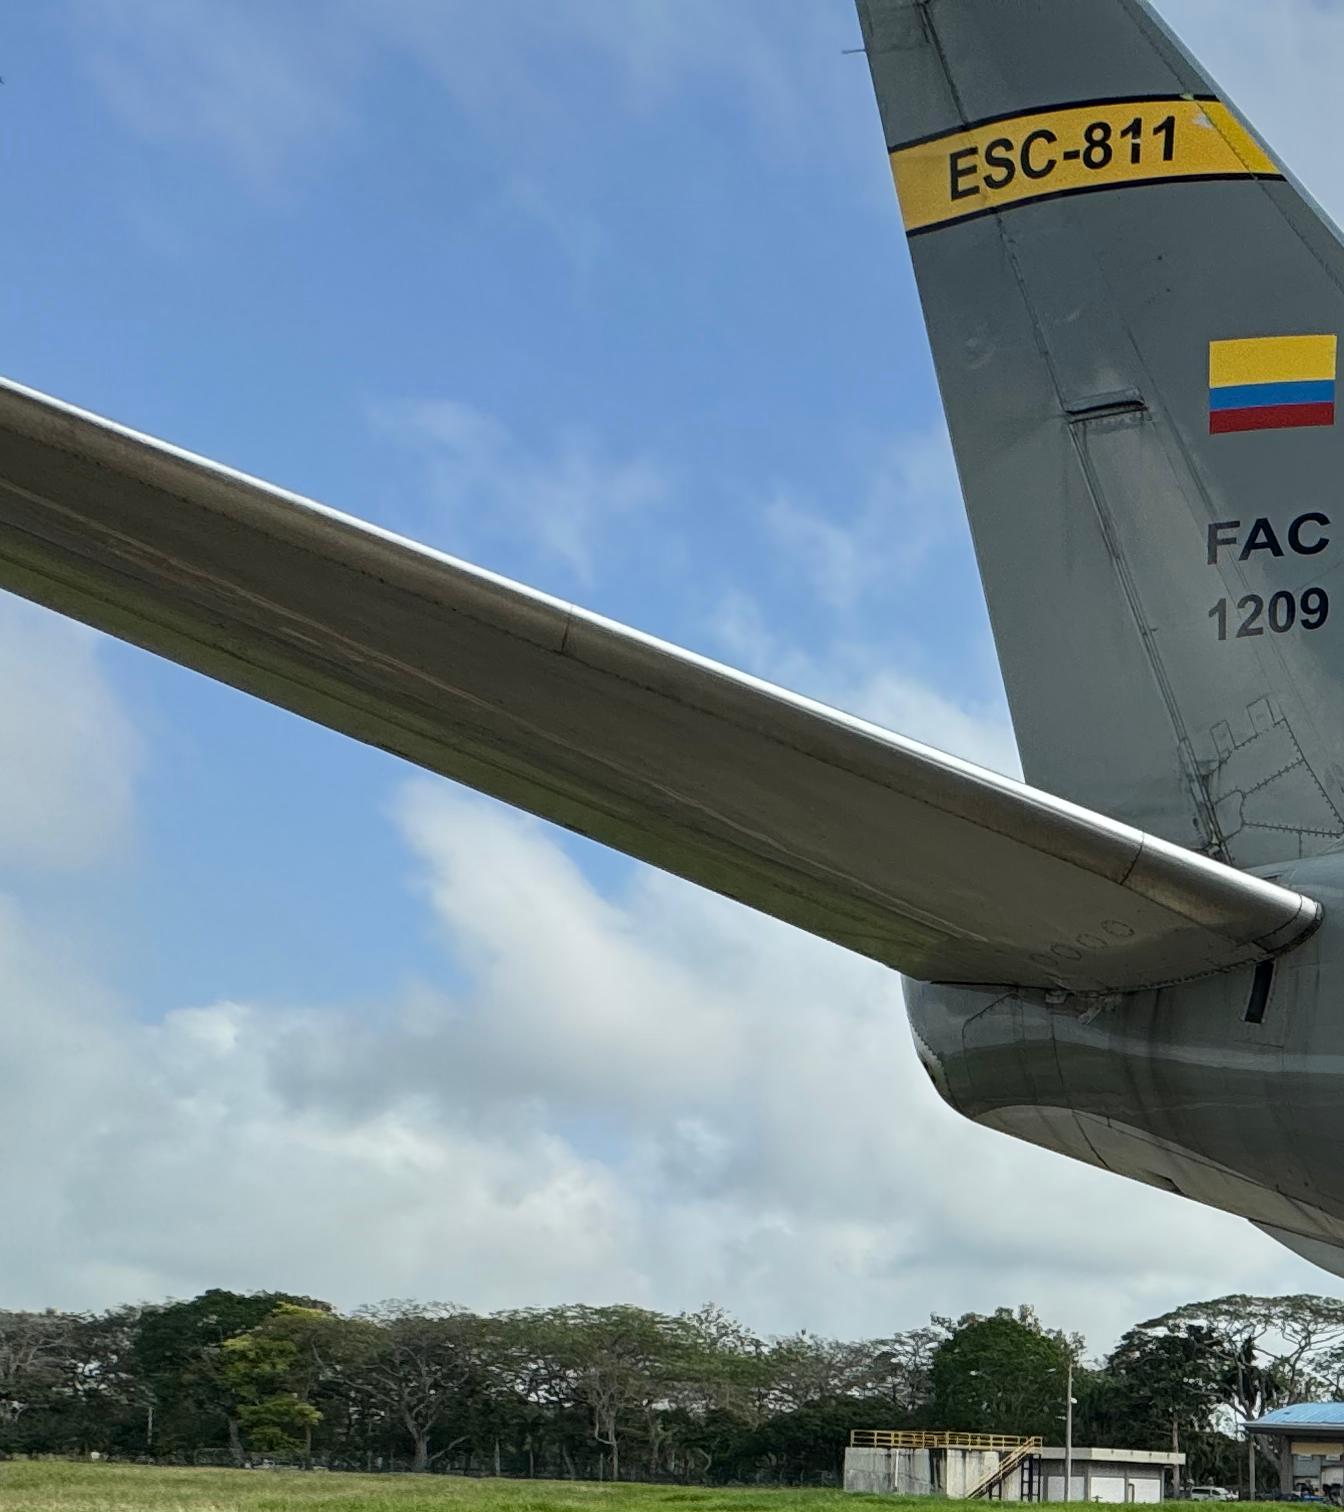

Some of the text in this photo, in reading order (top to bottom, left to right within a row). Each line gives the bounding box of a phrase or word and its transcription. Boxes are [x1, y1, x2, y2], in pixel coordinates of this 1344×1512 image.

[948, 115, 1176, 201] ESC-811
[1207, 511, 1331, 565] FAC
[1208, 587, 1329, 641] 1209
